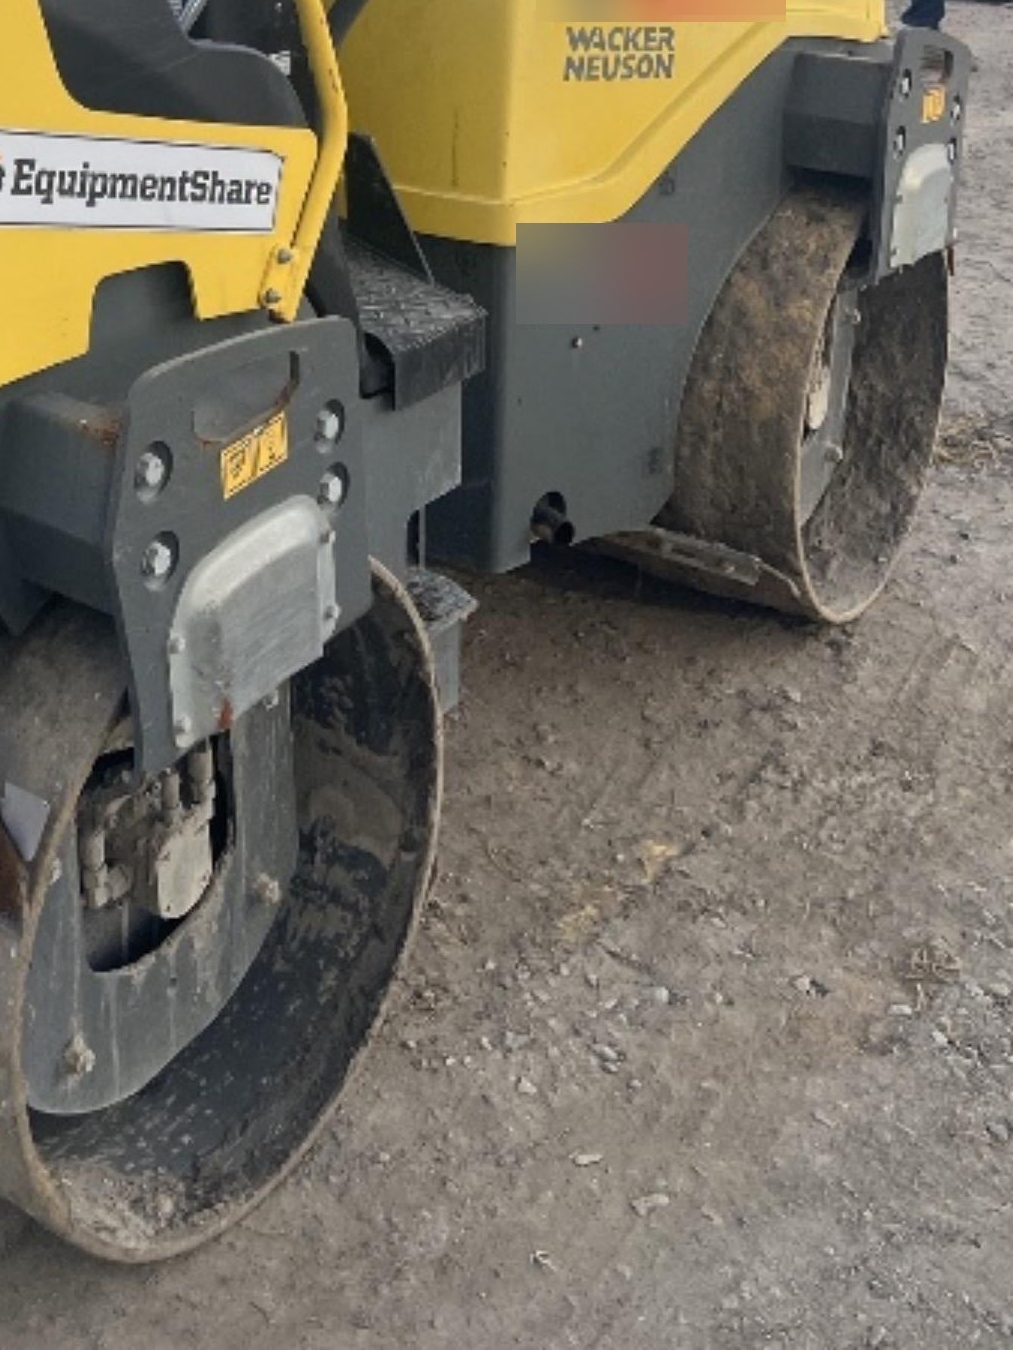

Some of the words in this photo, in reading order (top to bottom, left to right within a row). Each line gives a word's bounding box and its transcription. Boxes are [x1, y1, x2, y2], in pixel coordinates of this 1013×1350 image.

[566, 26, 676, 52] WACKER
[563, 53, 676, 81] NEUSON
[10, 158, 273, 208] EquipmentShare
